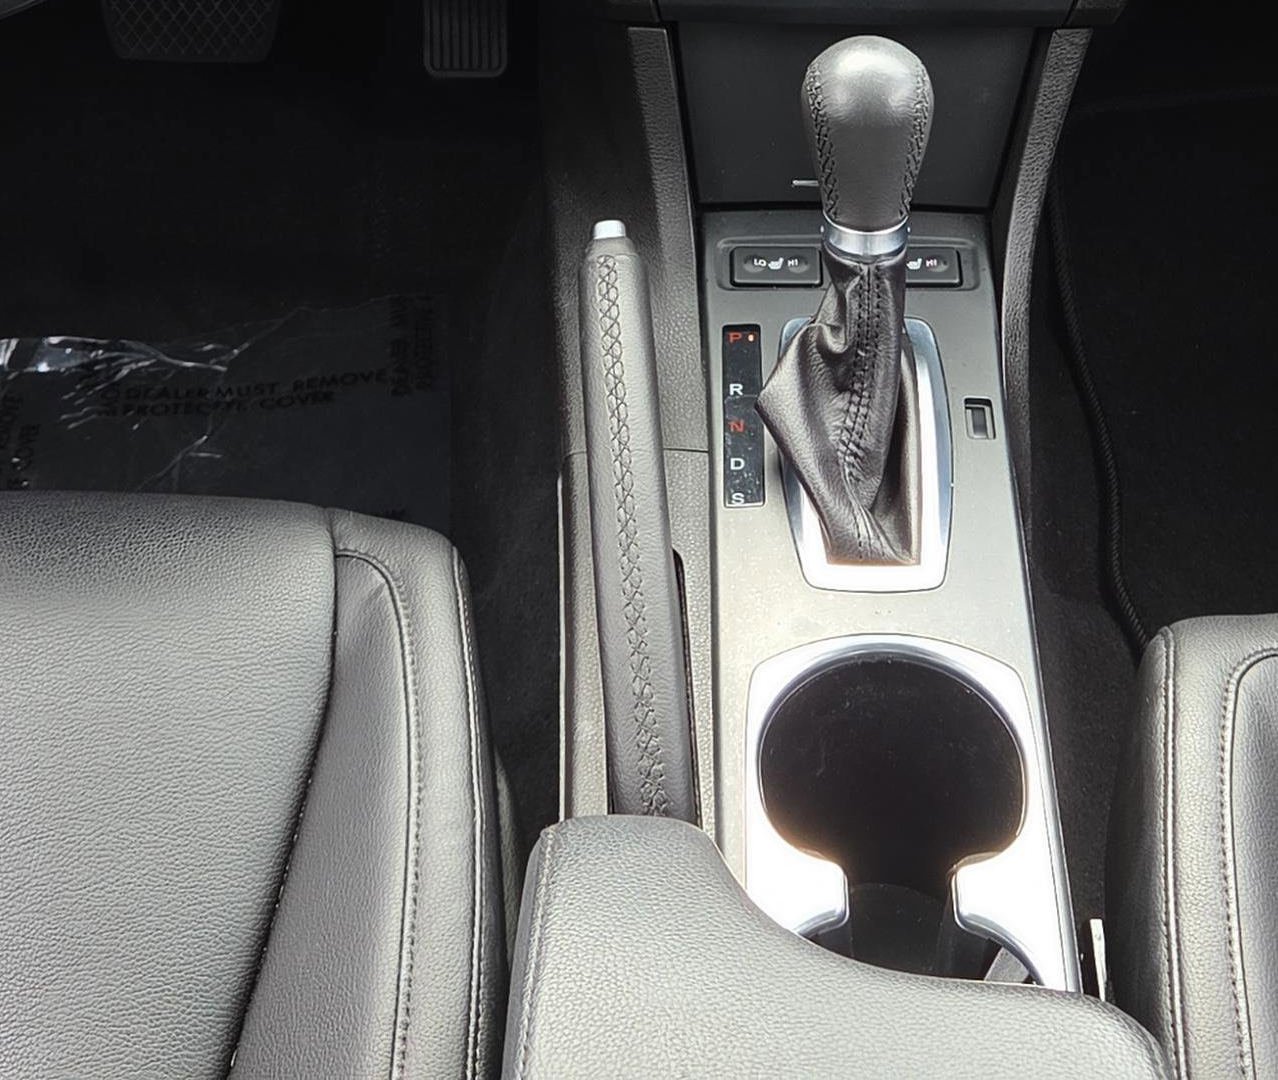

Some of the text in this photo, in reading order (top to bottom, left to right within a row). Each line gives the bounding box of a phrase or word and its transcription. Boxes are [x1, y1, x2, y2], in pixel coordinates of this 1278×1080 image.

[728, 331, 743, 344] P
[729, 382, 744, 396] R
[729, 419, 745, 433] N
[730, 457, 745, 471] D
[731, 492, 745, 505] S
